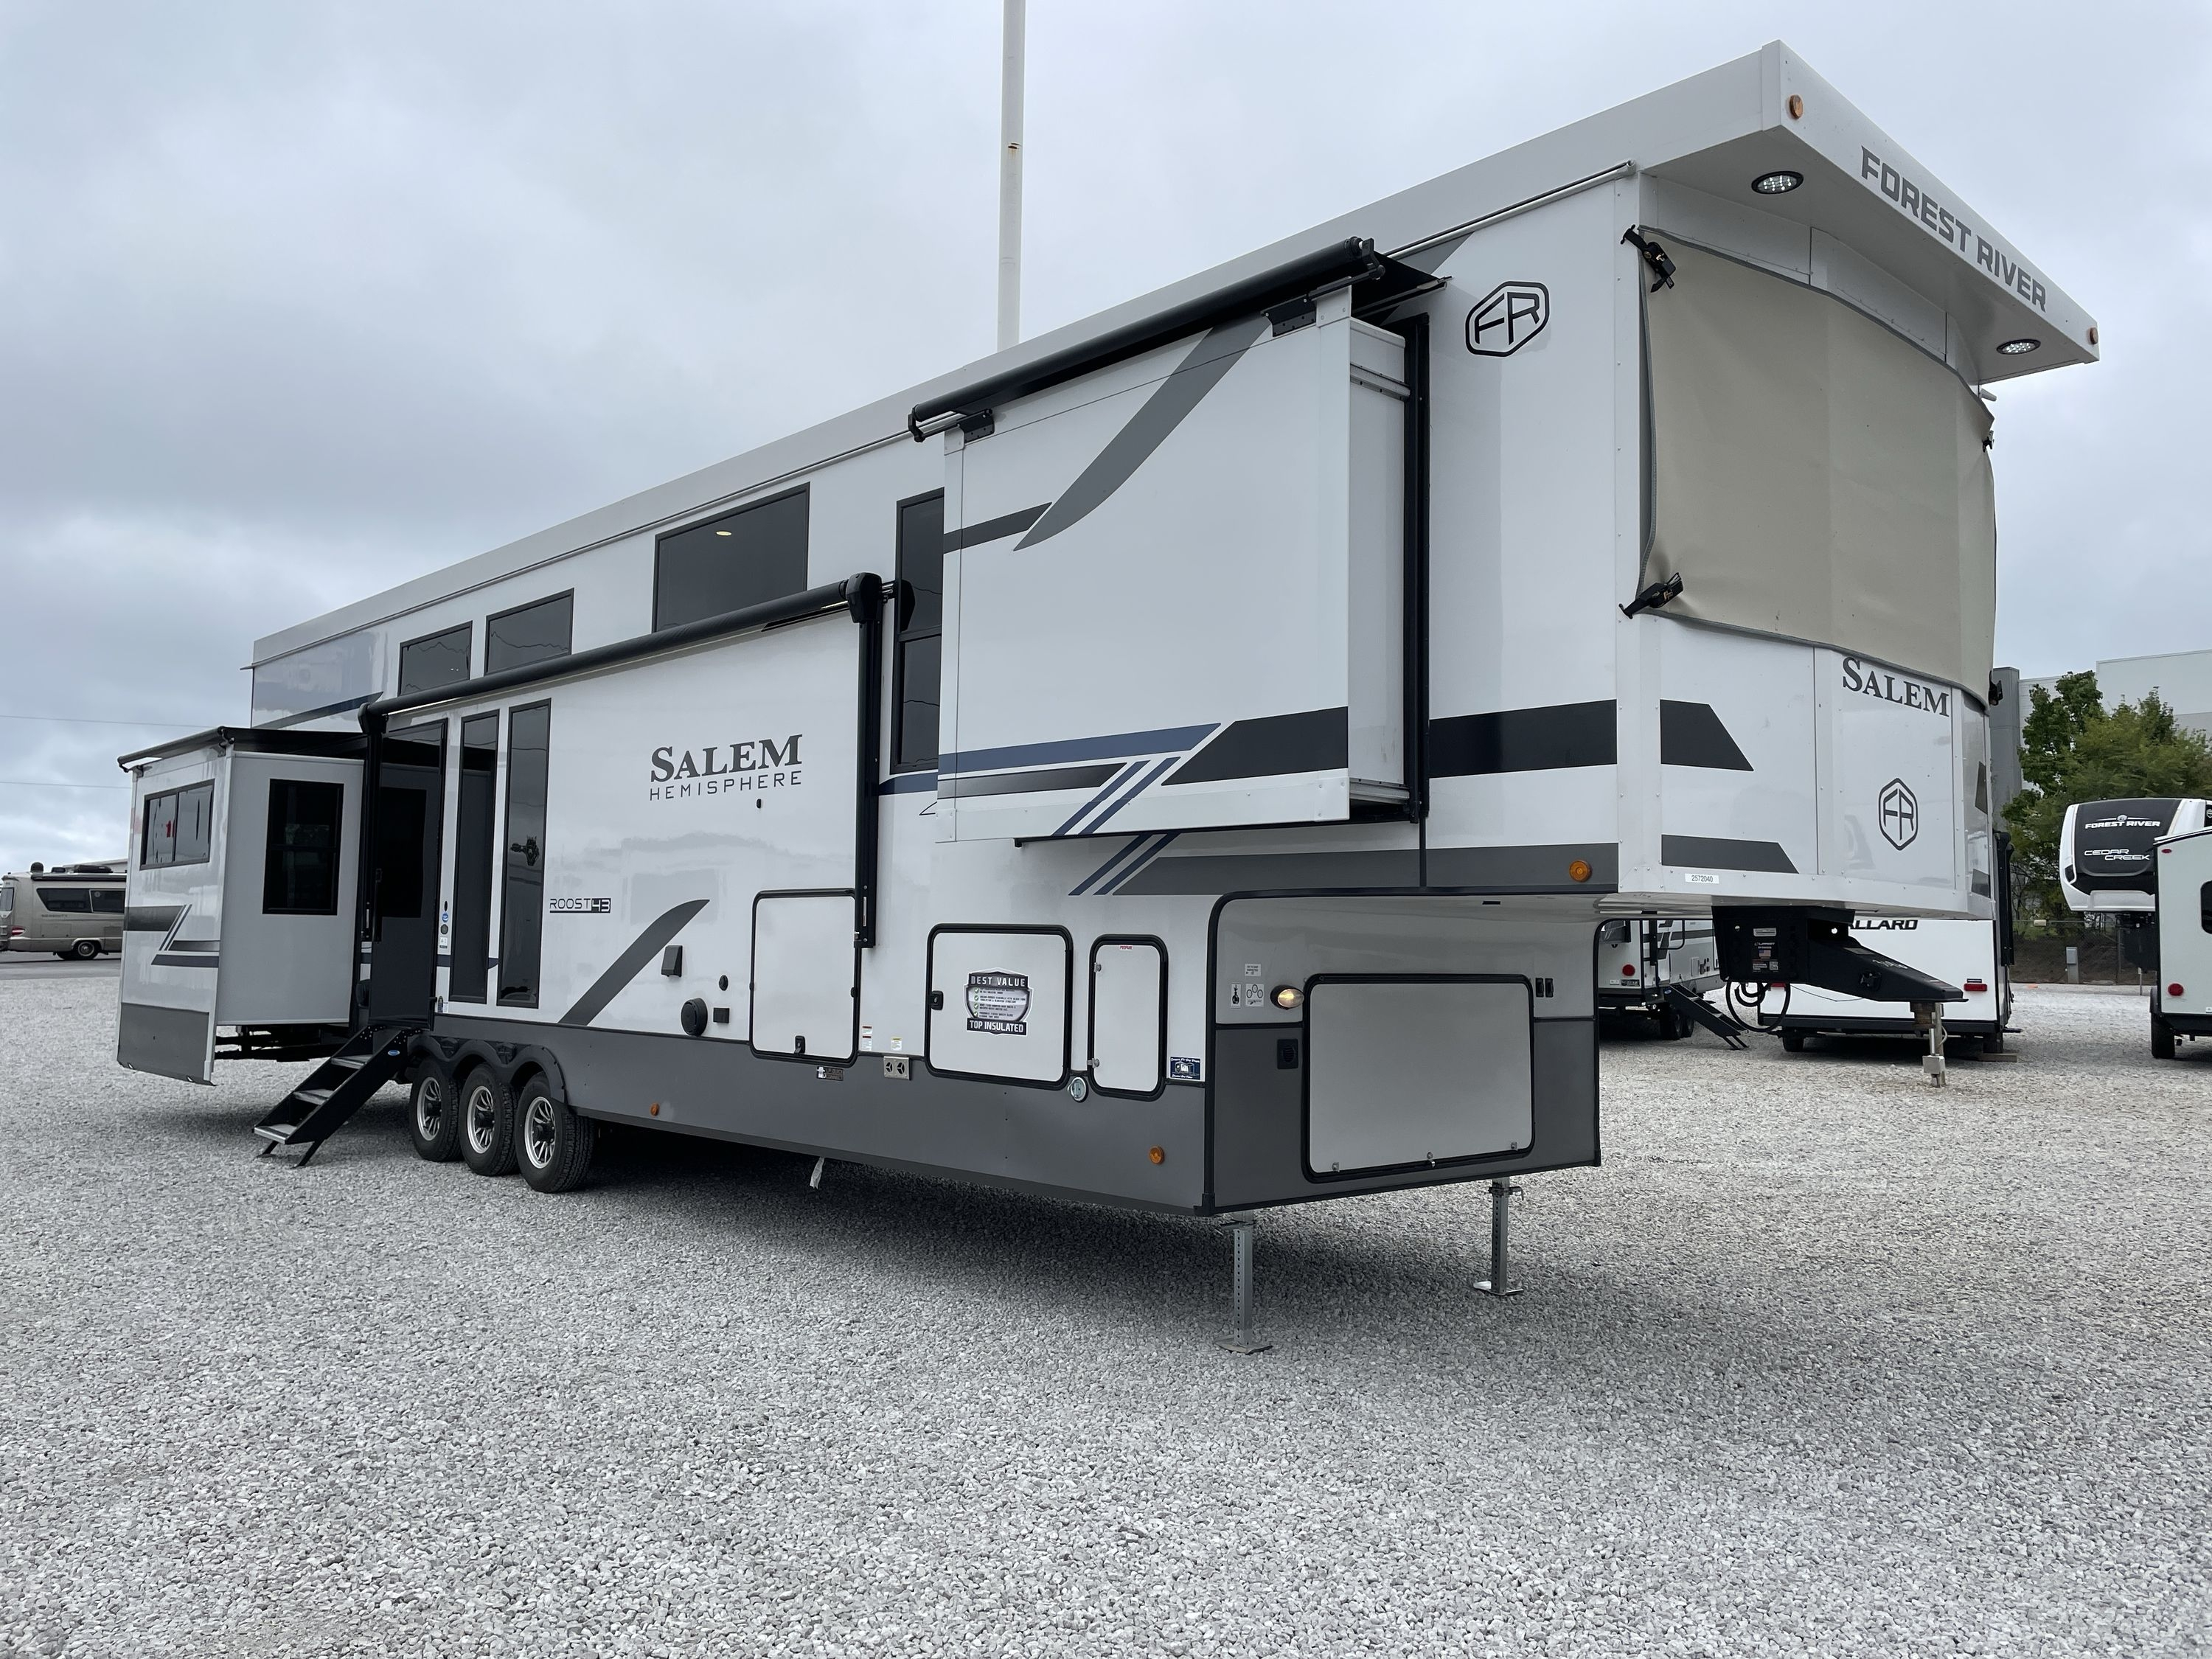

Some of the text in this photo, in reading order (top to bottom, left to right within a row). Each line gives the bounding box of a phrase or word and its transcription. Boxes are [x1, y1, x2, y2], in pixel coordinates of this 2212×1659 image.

[1861, 145, 2046, 313] FOREST RIVER
[1842, 656, 1950, 717] SALEM
[650, 734, 803, 782] SALEM
[650, 771, 802, 801] HEMISPHERE
[2084, 821, 2125, 830] FOREST
[1691, 874, 1714, 883] 2572040
[970, 975, 1026, 987] BEST VALUE
[969, 1020, 1024, 1032] TOP INSULATED
